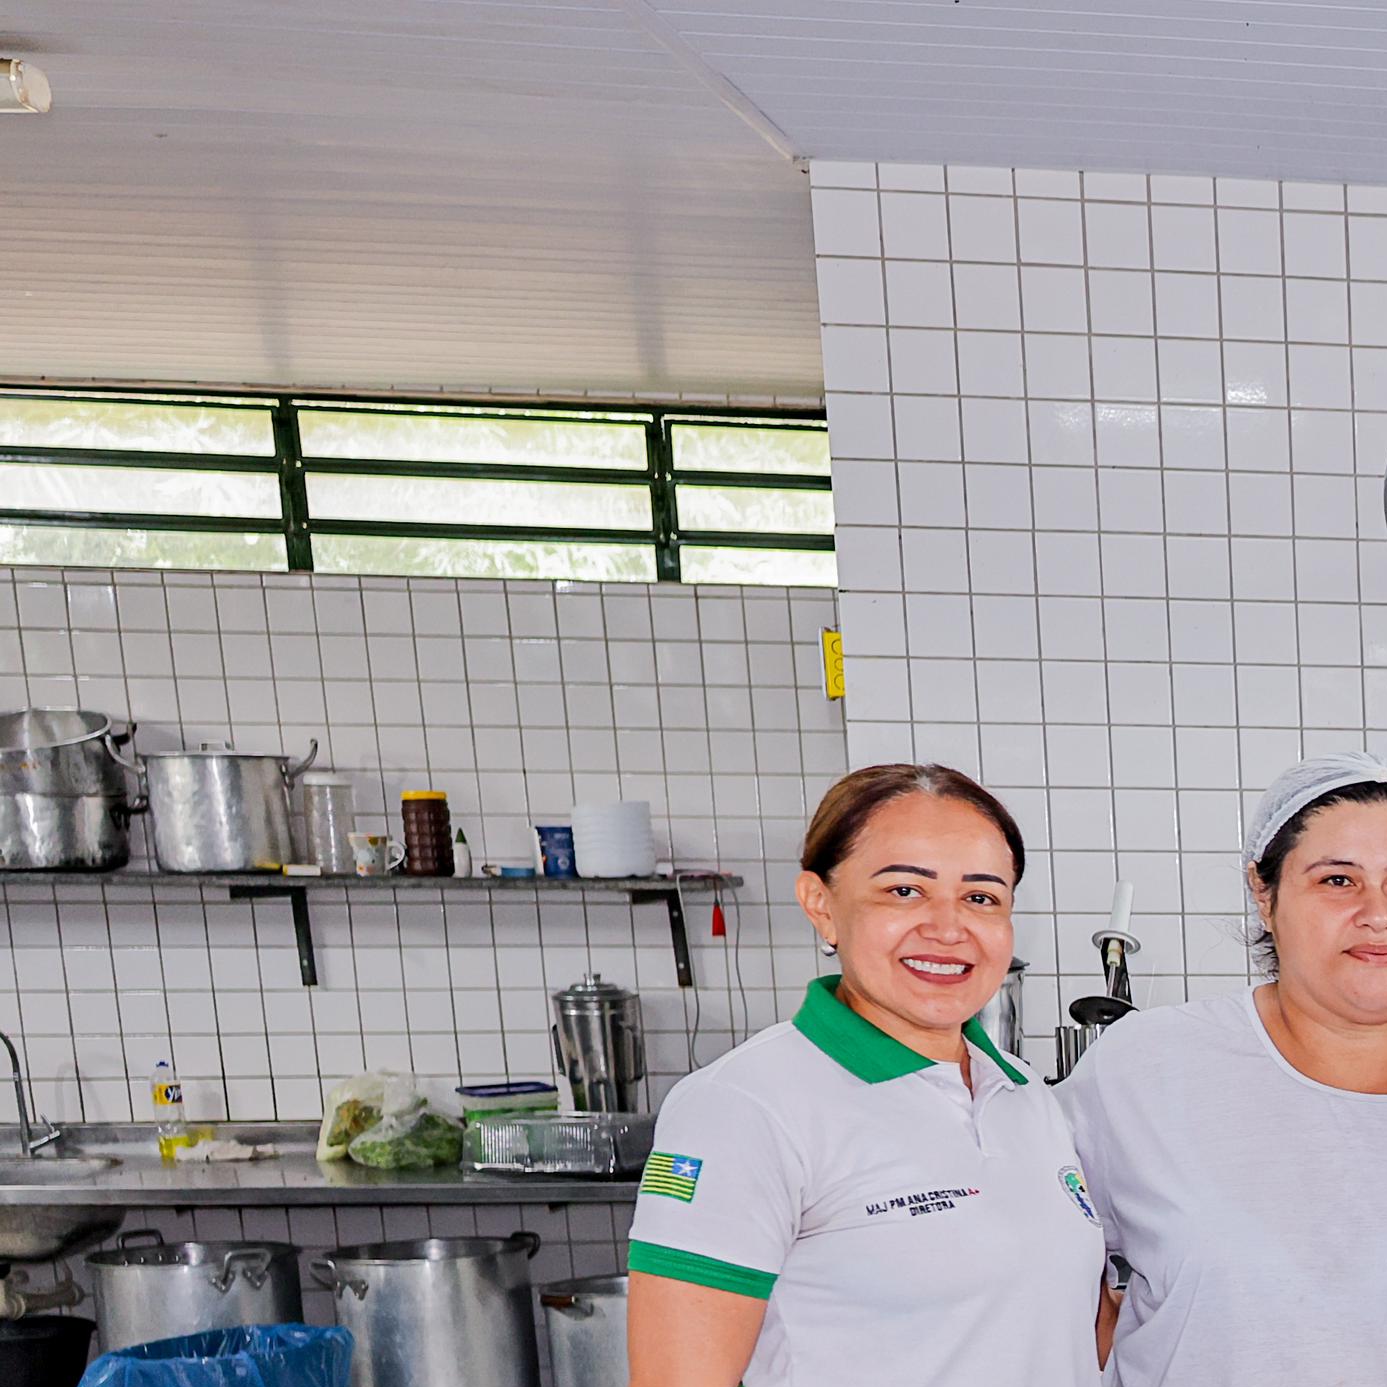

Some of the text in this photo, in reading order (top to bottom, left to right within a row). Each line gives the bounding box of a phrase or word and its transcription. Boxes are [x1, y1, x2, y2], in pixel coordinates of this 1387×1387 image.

[889, 1197, 907, 1209] PM
[907, 1193, 928, 1205] ANA
[927, 1188, 968, 1201] CRISTINA
[909, 1200, 956, 1217] DIRETORA
